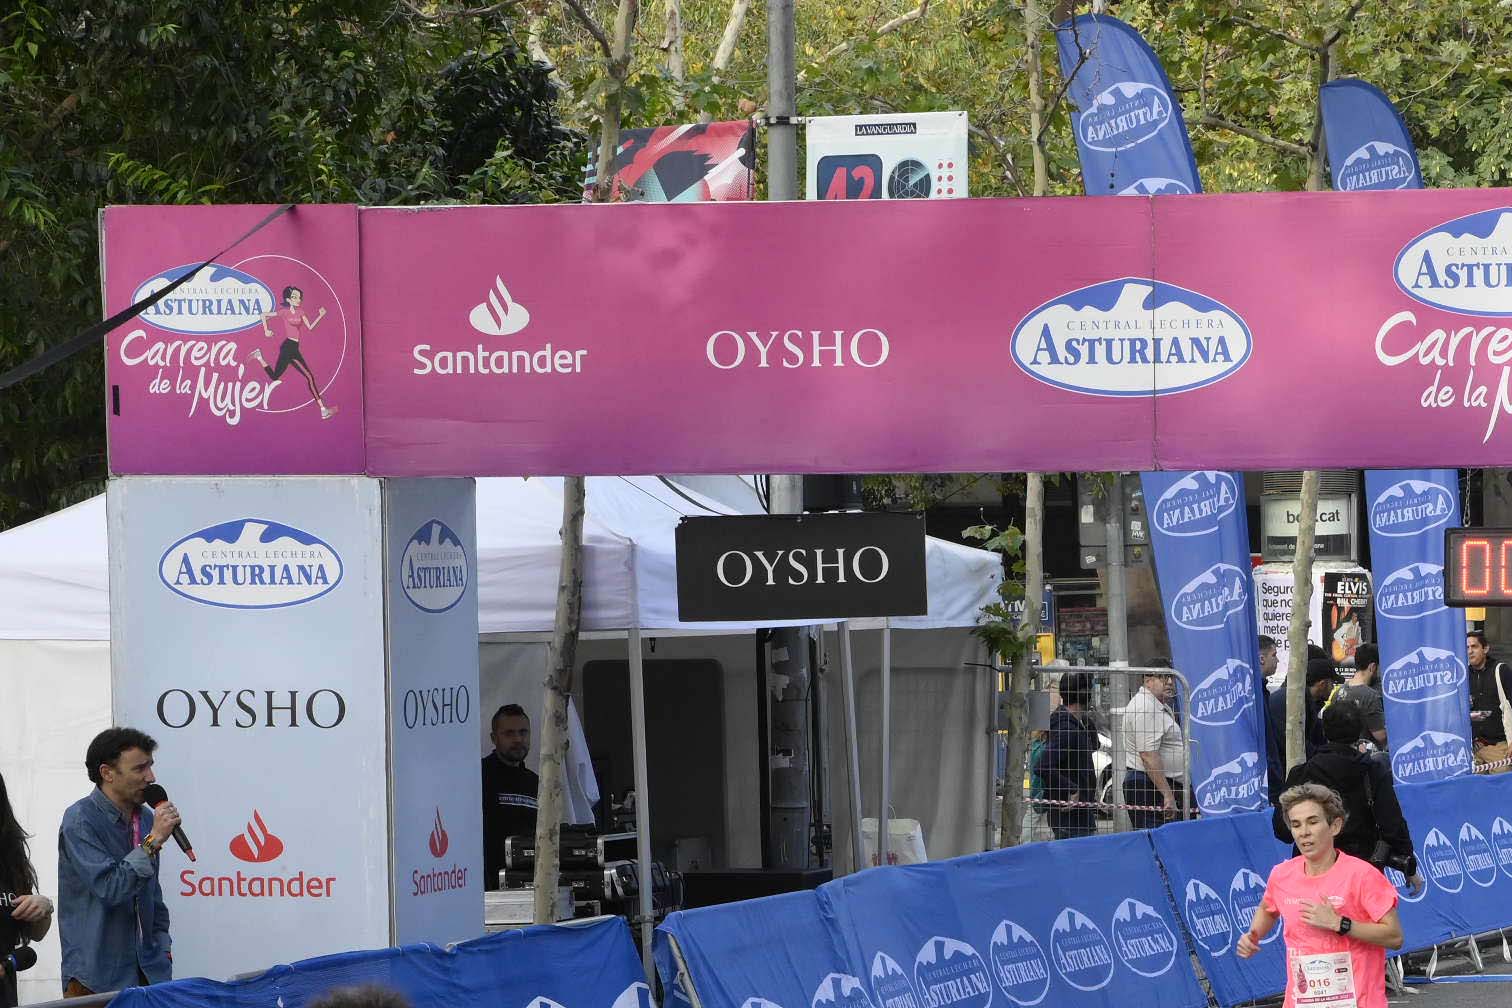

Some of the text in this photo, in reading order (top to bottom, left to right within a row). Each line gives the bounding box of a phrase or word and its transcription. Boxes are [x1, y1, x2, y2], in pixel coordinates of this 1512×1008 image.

[867, 124, 916, 134] VANGUARDIA
[143, 289, 264, 317] ASTURIANA
[213, 287, 260, 296] LECHERA
[1066, 317, 1225, 332] CENTRAL LECHERA
[119, 329, 238, 367] Carrera
[413, 343, 588, 375] Santander
[706, 328, 890, 370] OYSHO
[1029, 322, 1233, 366] ASTURIANA
[149, 363, 282, 426] de la Mujer
[1420, 369, 1455, 408] de
[1462, 367, 1488, 408] la
[173, 551, 330, 586] ASTURIANA
[201, 549, 324, 560] CENTRAL LECHERA
[716, 546, 890, 588] OYSHO
[406, 559, 465, 591] ASTURIANA
[1337, 581, 1368, 594] ELVIS
[1262, 598, 1278, 611] que
[1263, 623, 1289, 634] mete
[156, 688, 347, 729] OYSHO
[404, 684, 470, 730] OYSHO
[179, 869, 337, 898] Santander
[412, 864, 469, 897] Santander
[995, 954, 1047, 988] ASTURIANA
[1056, 940, 1111, 973] ASTURIANA
[1309, 978, 1331, 989] 016
